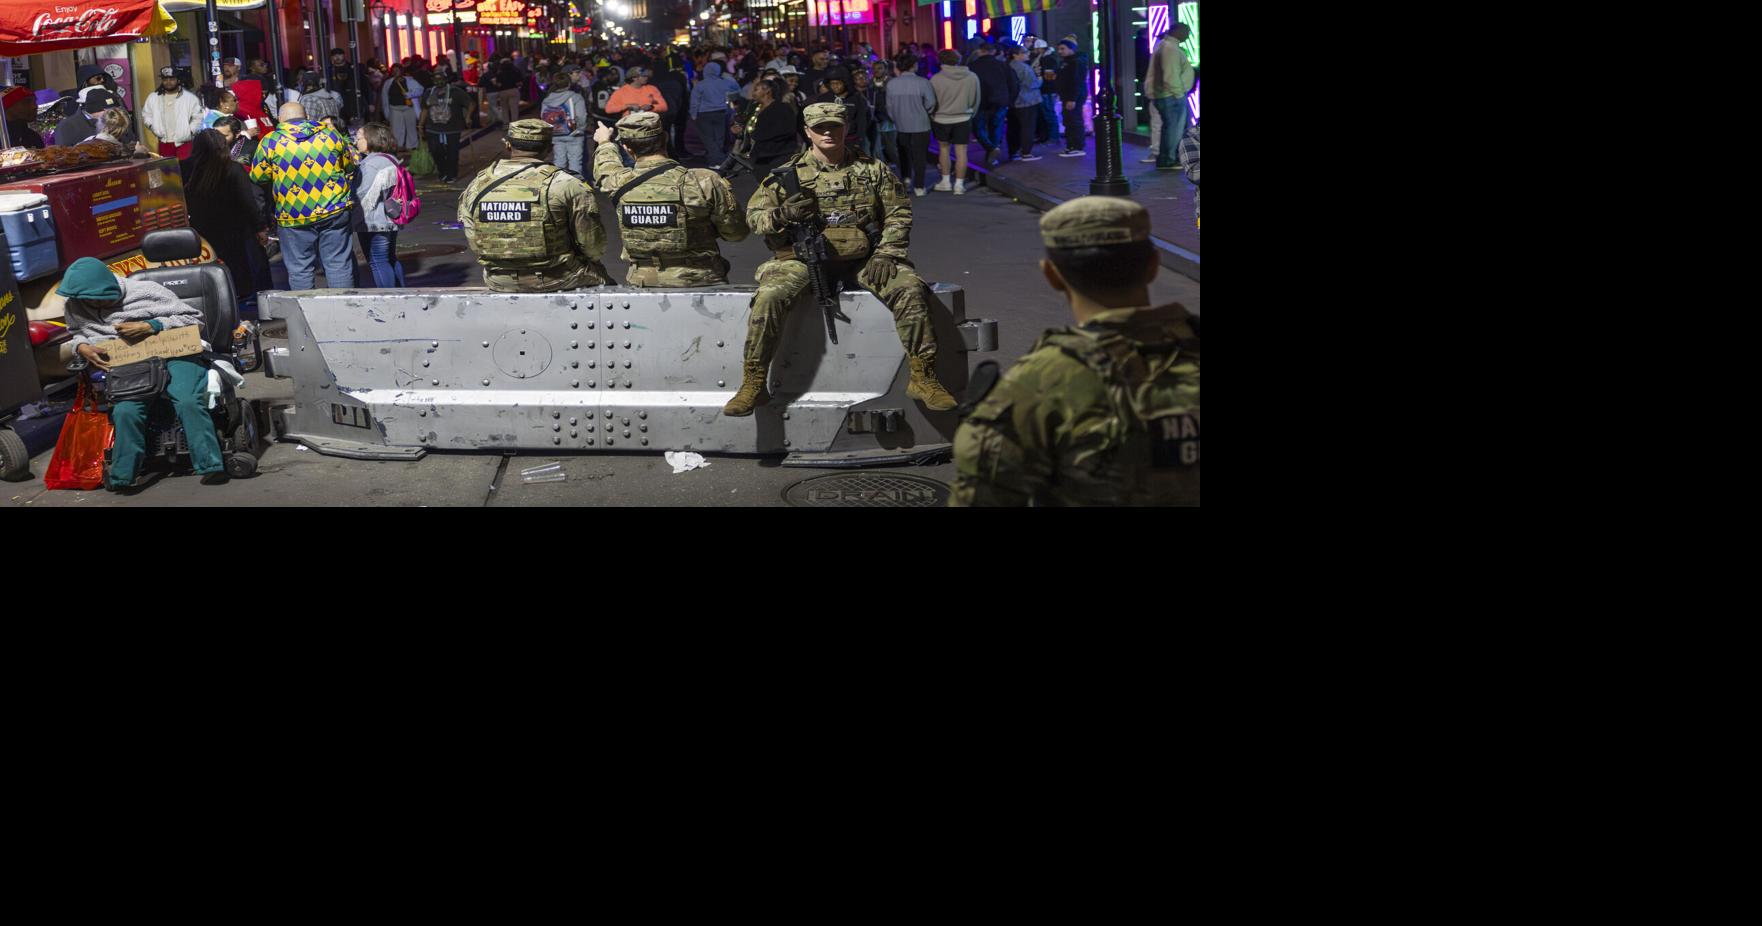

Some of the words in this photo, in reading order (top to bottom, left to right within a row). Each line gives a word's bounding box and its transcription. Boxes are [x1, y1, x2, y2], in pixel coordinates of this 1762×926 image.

[32, 8, 119, 36] Coca-Cola
[481, 202, 528, 211] NATIONAL
[624, 205, 673, 214] NATIONAL
[487, 212, 522, 221] GUARD
[631, 215, 667, 224] GUARD
[813, 488, 928, 502] DRAIN
